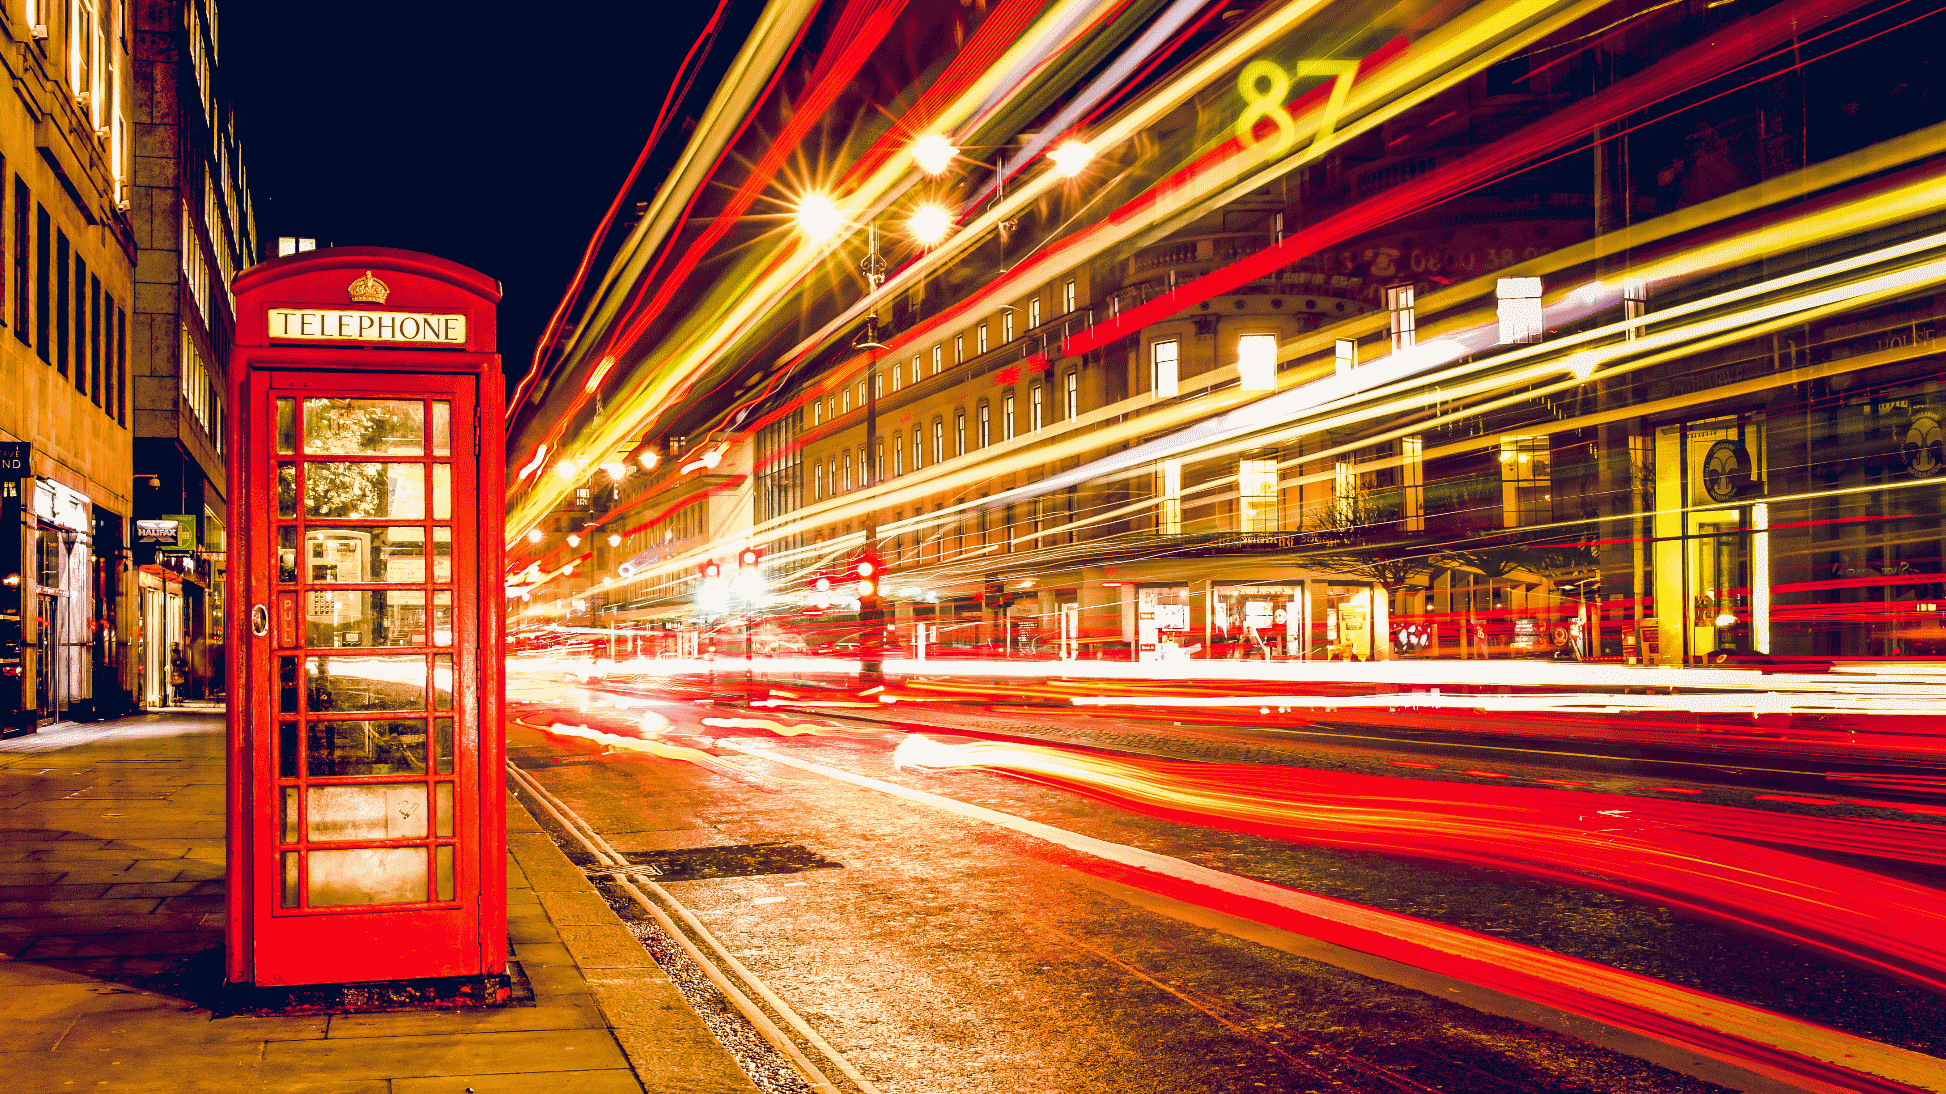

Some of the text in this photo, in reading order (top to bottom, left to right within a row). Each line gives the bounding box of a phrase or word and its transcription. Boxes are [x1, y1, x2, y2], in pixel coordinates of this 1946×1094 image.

[1235, 59, 1362, 159] 87
[276, 311, 460, 342] TELEPHONE
[137, 528, 177, 538] HALIFAX
[284, 599, 292, 642] PULL
